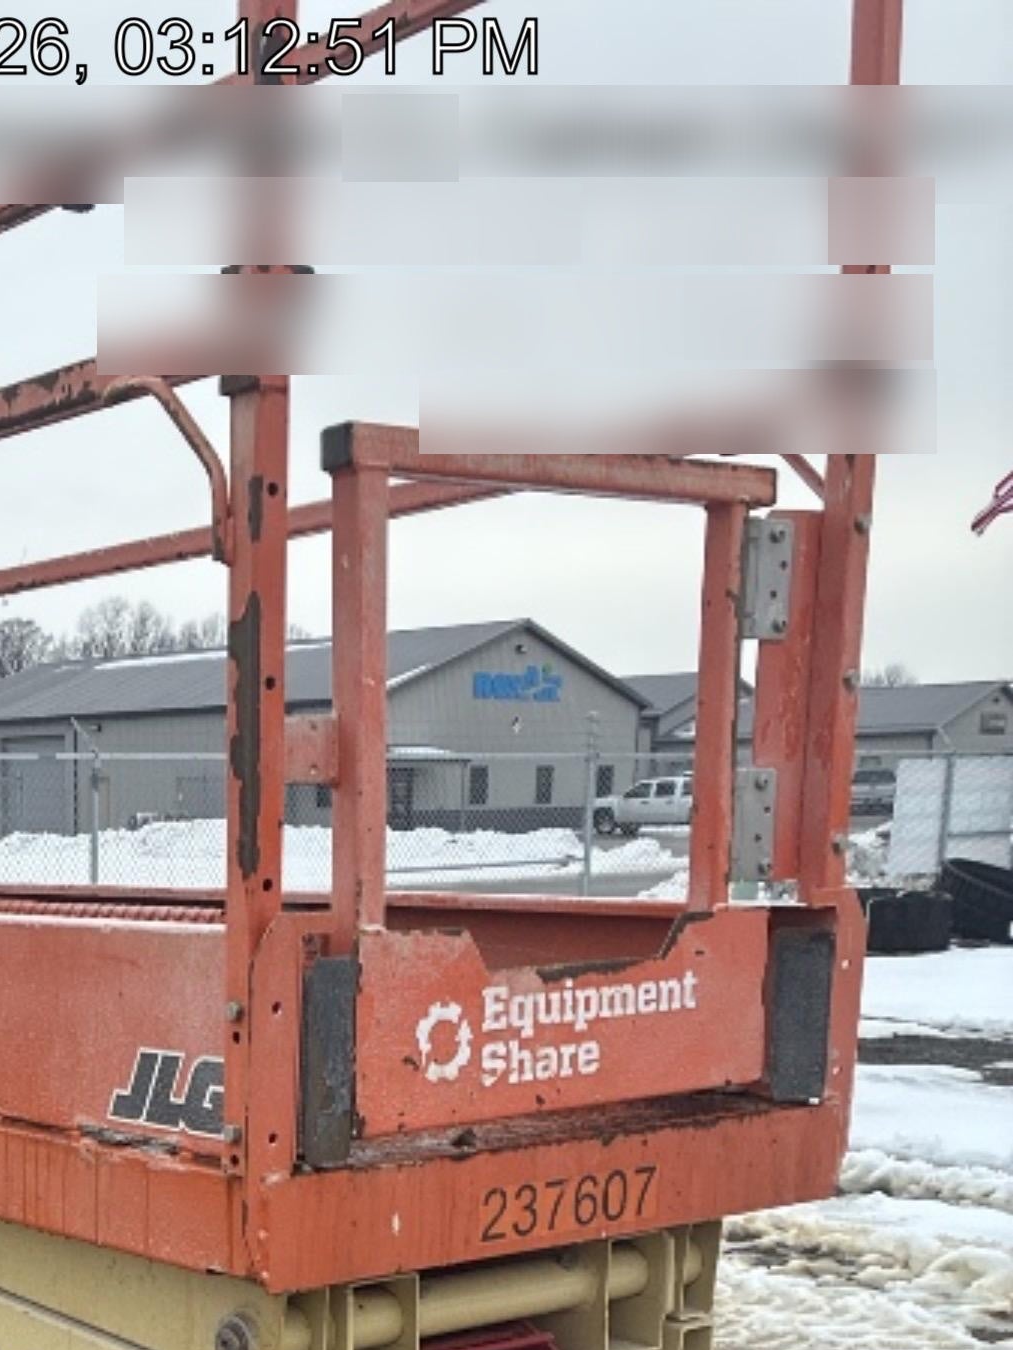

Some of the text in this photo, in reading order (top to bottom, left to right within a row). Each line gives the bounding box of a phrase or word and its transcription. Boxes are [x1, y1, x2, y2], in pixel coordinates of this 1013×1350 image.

[480, 969, 699, 1035] Equipment
[480, 1038, 601, 1087] Share
[479, 1164, 659, 1244] 237607
